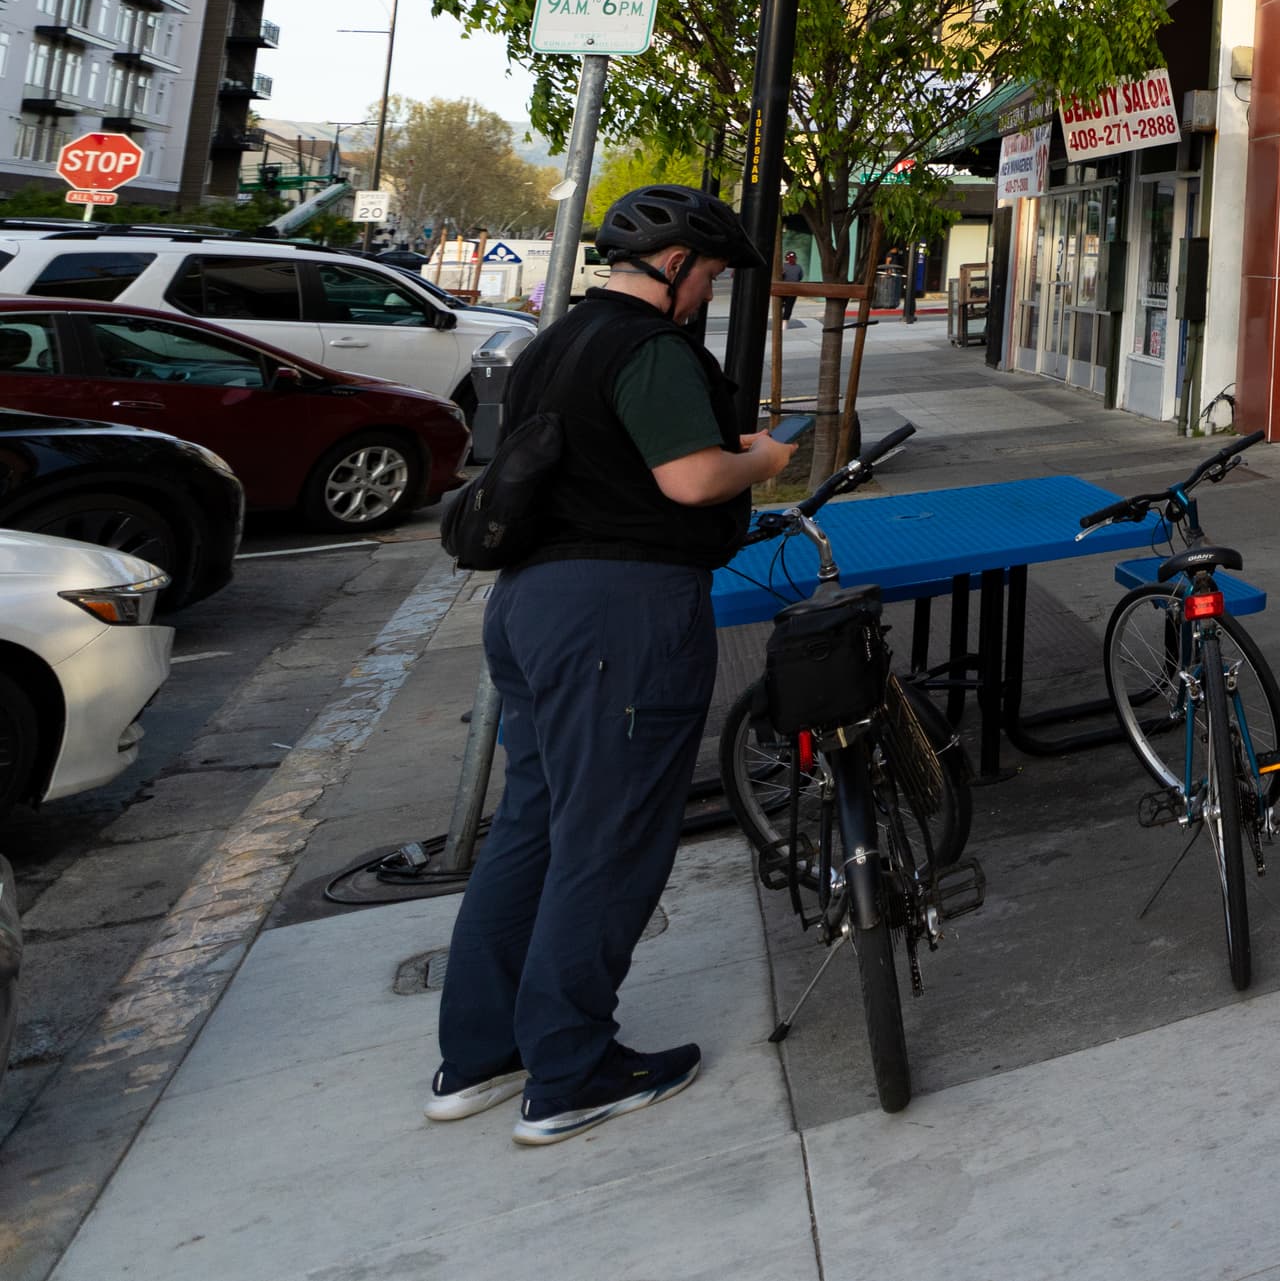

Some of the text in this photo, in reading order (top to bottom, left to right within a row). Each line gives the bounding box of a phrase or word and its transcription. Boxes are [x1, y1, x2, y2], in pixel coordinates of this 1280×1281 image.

[1122, 77, 1171, 114] SALON
[1069, 114, 1176, 152] 408-271-2888
[64, 149, 138, 174] STOP
[71, 193, 113, 203] ALL WAY
[359, 207, 383, 219] 20
